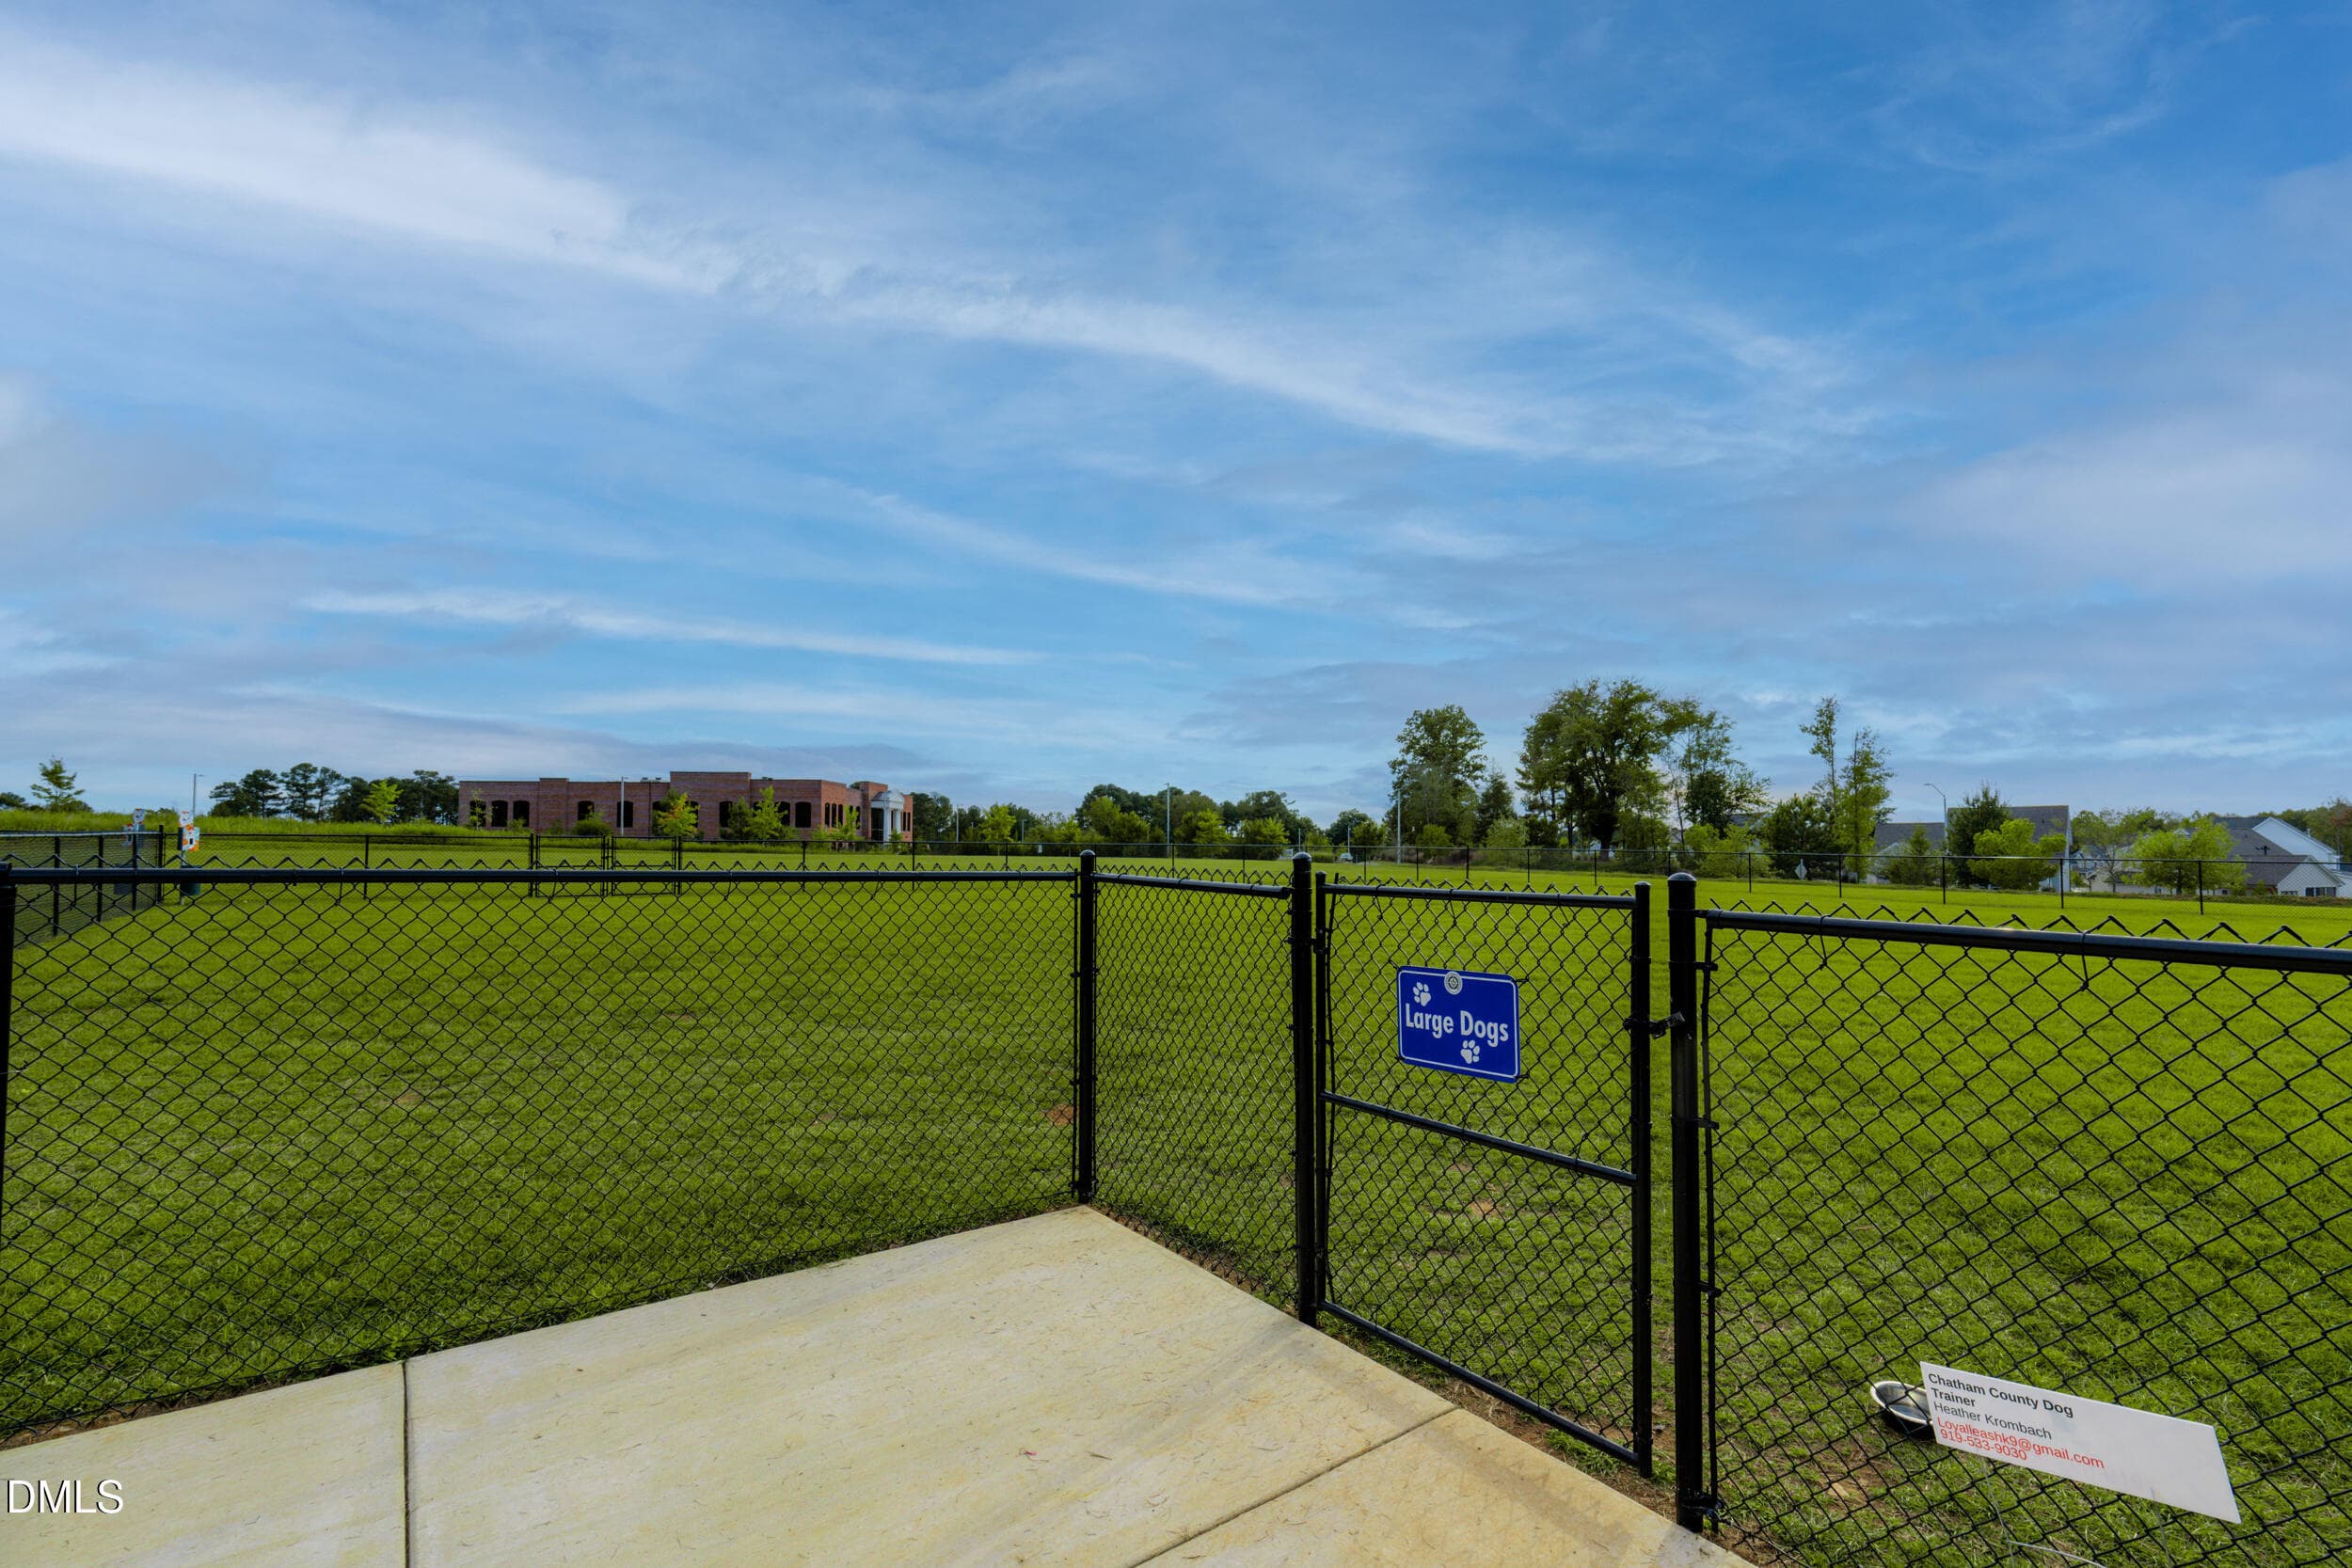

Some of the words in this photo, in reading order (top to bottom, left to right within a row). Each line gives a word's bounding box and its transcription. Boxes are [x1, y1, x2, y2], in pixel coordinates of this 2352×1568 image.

[1406, 1003, 1454, 1038] Large
[1460, 1010, 1509, 1047] Dogs
[1928, 1373, 1986, 1395] Chatham
[1989, 1387, 2039, 1409] County
[2042, 1400, 2074, 1418] Dog
[1931, 1387, 1976, 1406] Trainer
[1934, 1402, 1980, 1421] Heather
[1985, 1414, 2052, 1439] Krombach
[1937, 1416, 2105, 1468] Loyalleashk9@gmail.com
[1940, 1429, 2027, 1461] 919-533-9030
